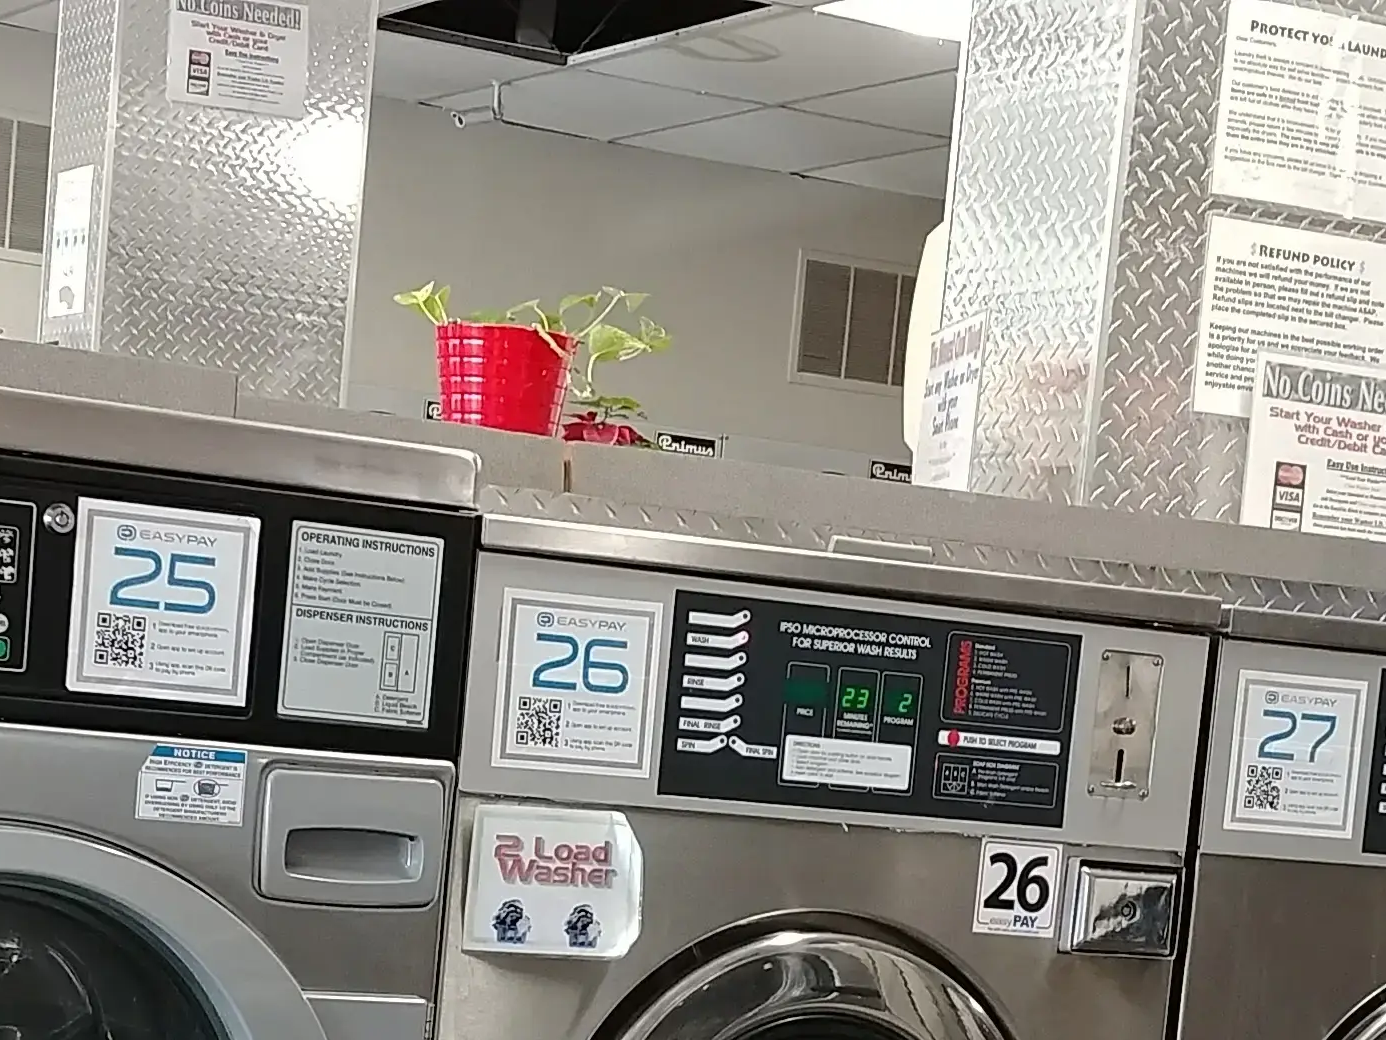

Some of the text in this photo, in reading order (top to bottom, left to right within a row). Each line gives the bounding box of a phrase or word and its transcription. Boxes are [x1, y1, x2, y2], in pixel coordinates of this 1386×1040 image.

[201, 0, 239, 19] Coins
[244, 2, 301, 30] Needed!
[1250, 20, 1309, 42] PROTECT
[1259, 245, 1355, 271] REFUND POLICY
[1263, 364, 1292, 398] No
[1298, 371, 1352, 408] Coins
[1269, 407, 1300, 420] Start
[1305, 411, 1333, 425] Your
[1336, 416, 1381, 432] Washer
[1294, 423, 1319, 435] with
[1324, 427, 1352, 439] Cash
[1357, 433, 1369, 441] or
[1298, 434, 1367, 453] Credit/Debit
[1327, 459, 1344, 471] Easy
[1279, 491, 1299, 502] VISA
[140, 531, 217, 547] EASYPAY
[301, 532, 435, 557] OPERATING INSTRUCTIONS
[108, 547, 217, 614] 25
[296, 609, 428, 631] DISPENSER INSTRUCTIONS
[557, 616, 628, 632] EASYPAY
[780, 622, 931, 648] IPSO MICROPROCESSOR CONTROL
[792, 637, 917, 660] FOR SUPERIOR WASH RESULTS
[532, 633, 630, 694] 26
[687, 677, 705, 687] RINSE
[953, 640, 973, 715] PROGRAMS
[842, 688, 869, 709] 23
[899, 693, 913, 713] 2
[1281, 693, 1337, 708] EASYPAY
[683, 718, 721, 731] FINAL RINSE
[883, 716, 913, 726] PROGRAM
[681, 740, 696, 750] SPIN
[963, 735, 1037, 749] PUSH TO SELECT PROGRAM
[1258, 709, 1339, 763] 27
[173, 748, 215, 760] NOTICE
[495, 834, 611, 865] 2 Load
[498, 857, 618, 889] Washer
[983, 852, 1050, 913] 26
[1013, 915, 1039, 929] PAY
